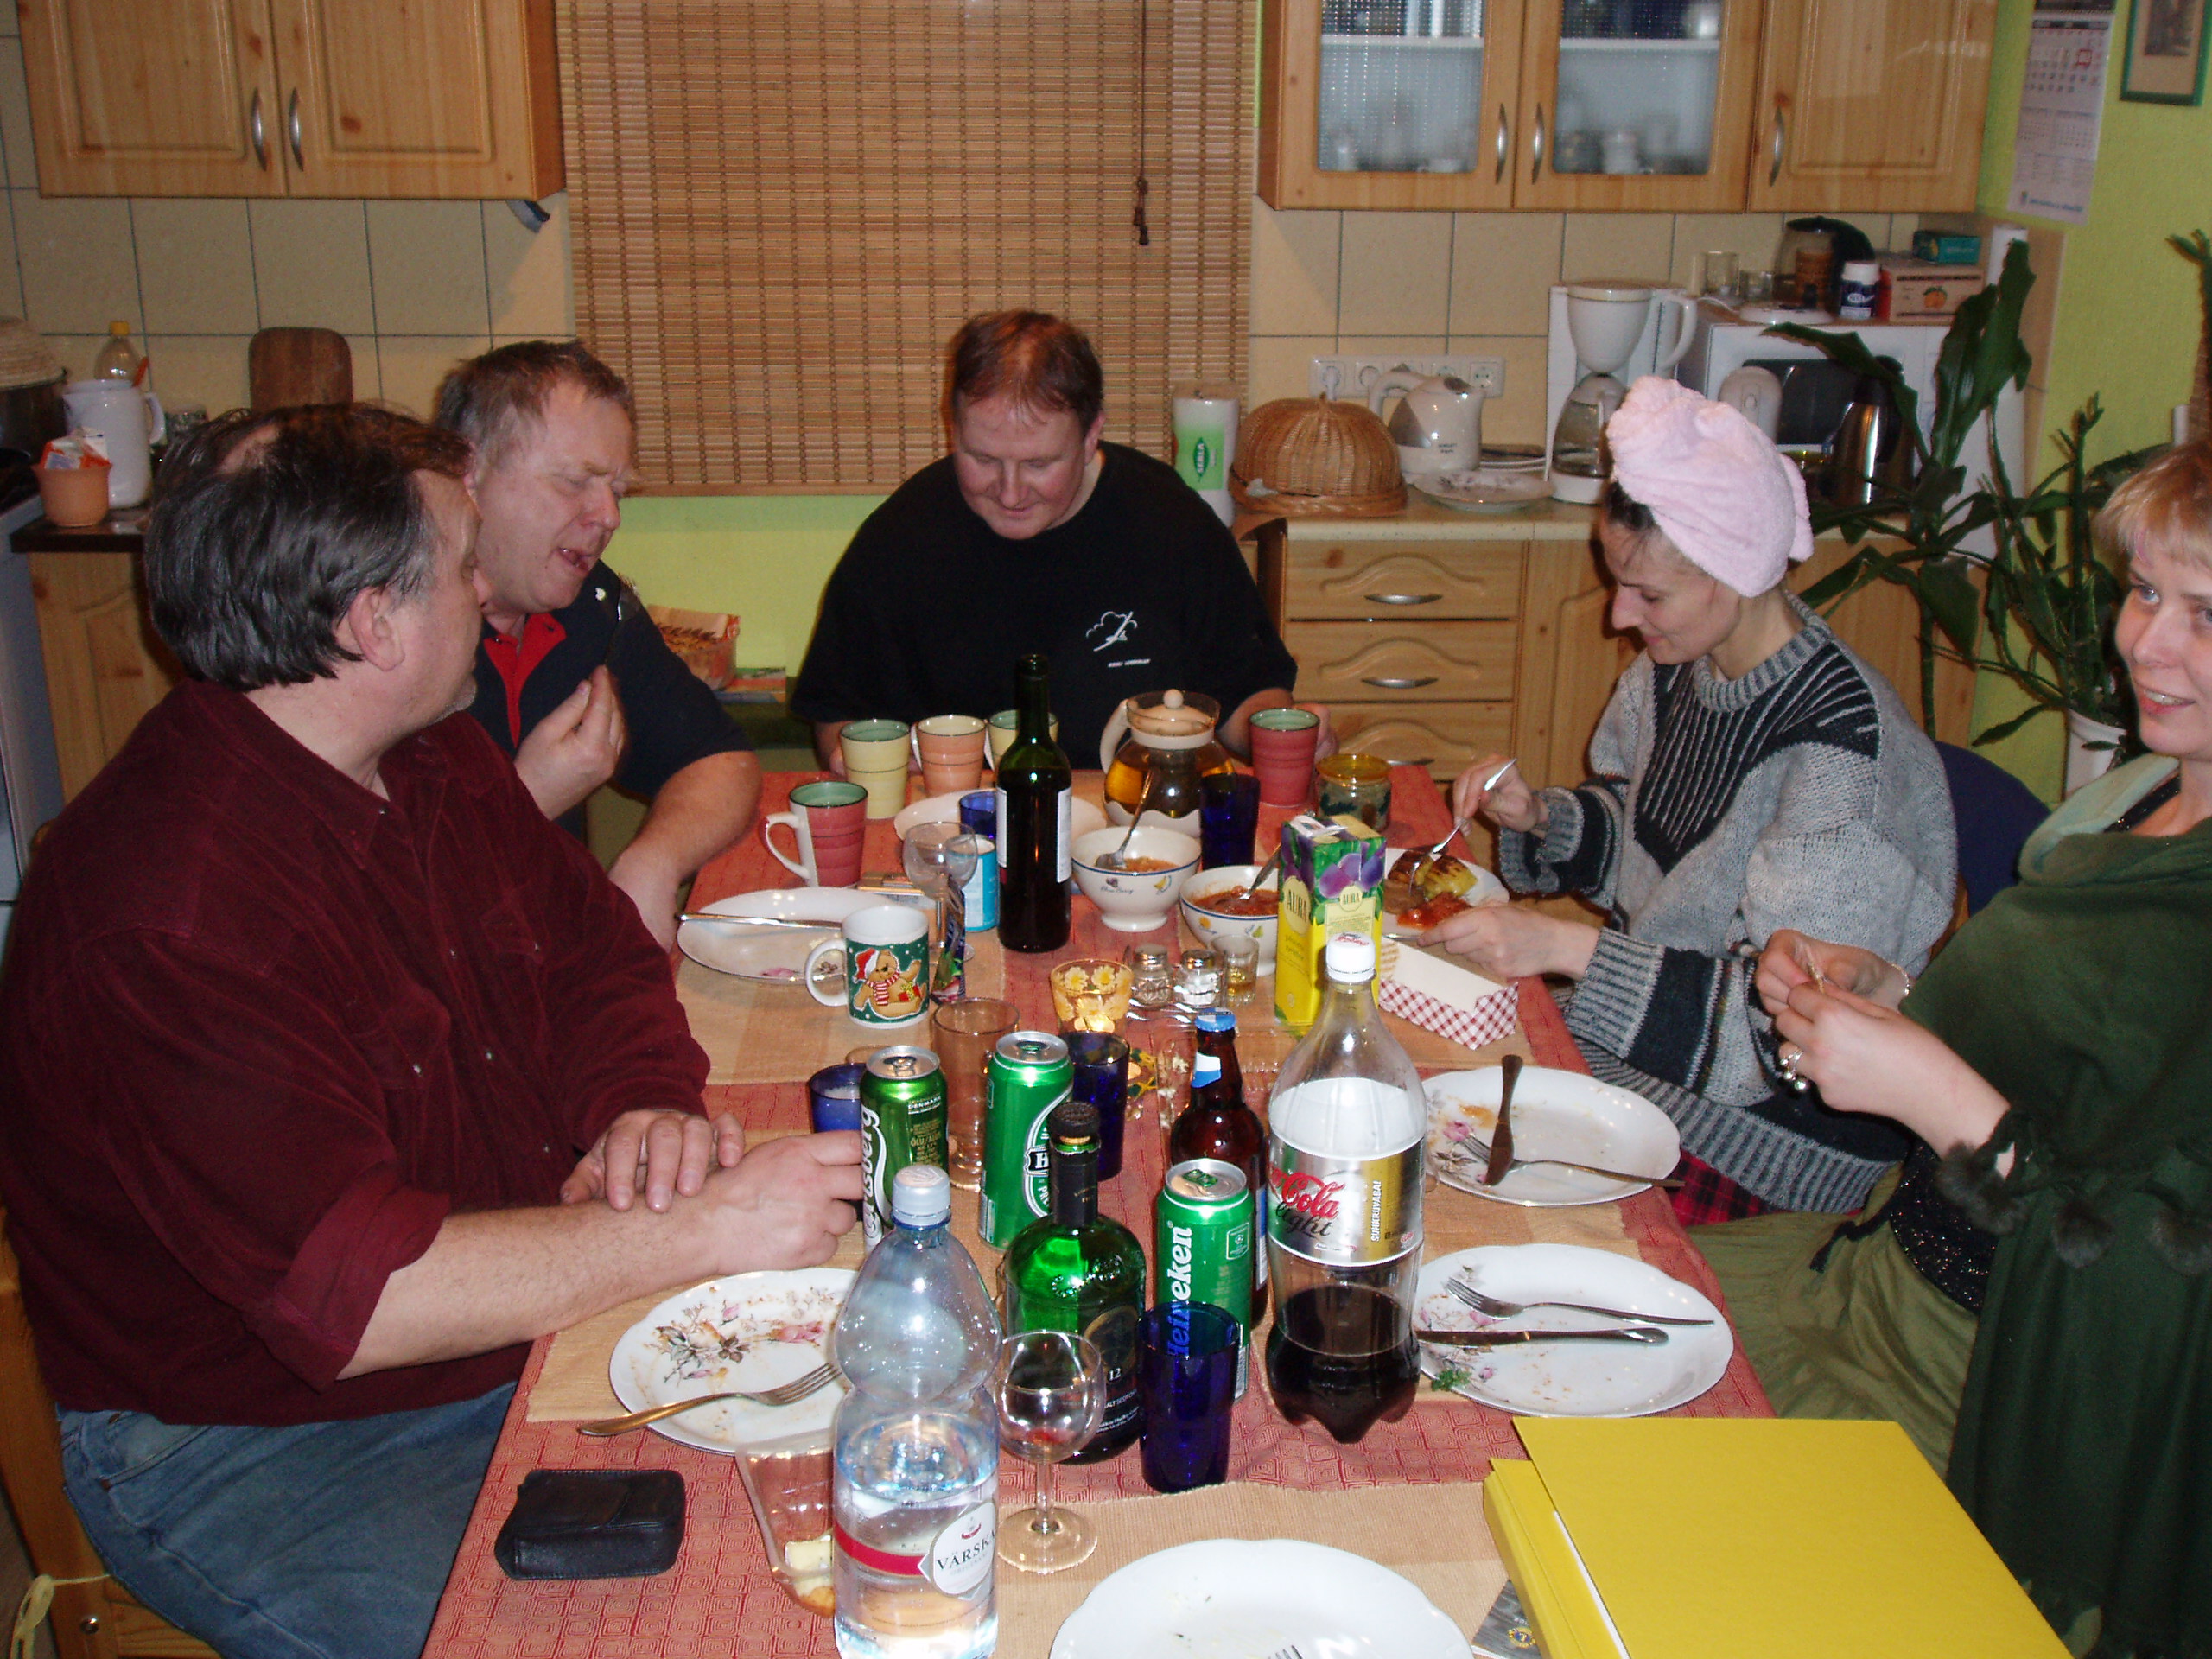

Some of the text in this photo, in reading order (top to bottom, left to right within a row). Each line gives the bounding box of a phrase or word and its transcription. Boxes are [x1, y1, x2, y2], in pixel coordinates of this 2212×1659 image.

[1287, 888, 1307, 923] AURA
[1342, 891, 1360, 906] AURA
[1108, 1368, 1122, 1382] 12
